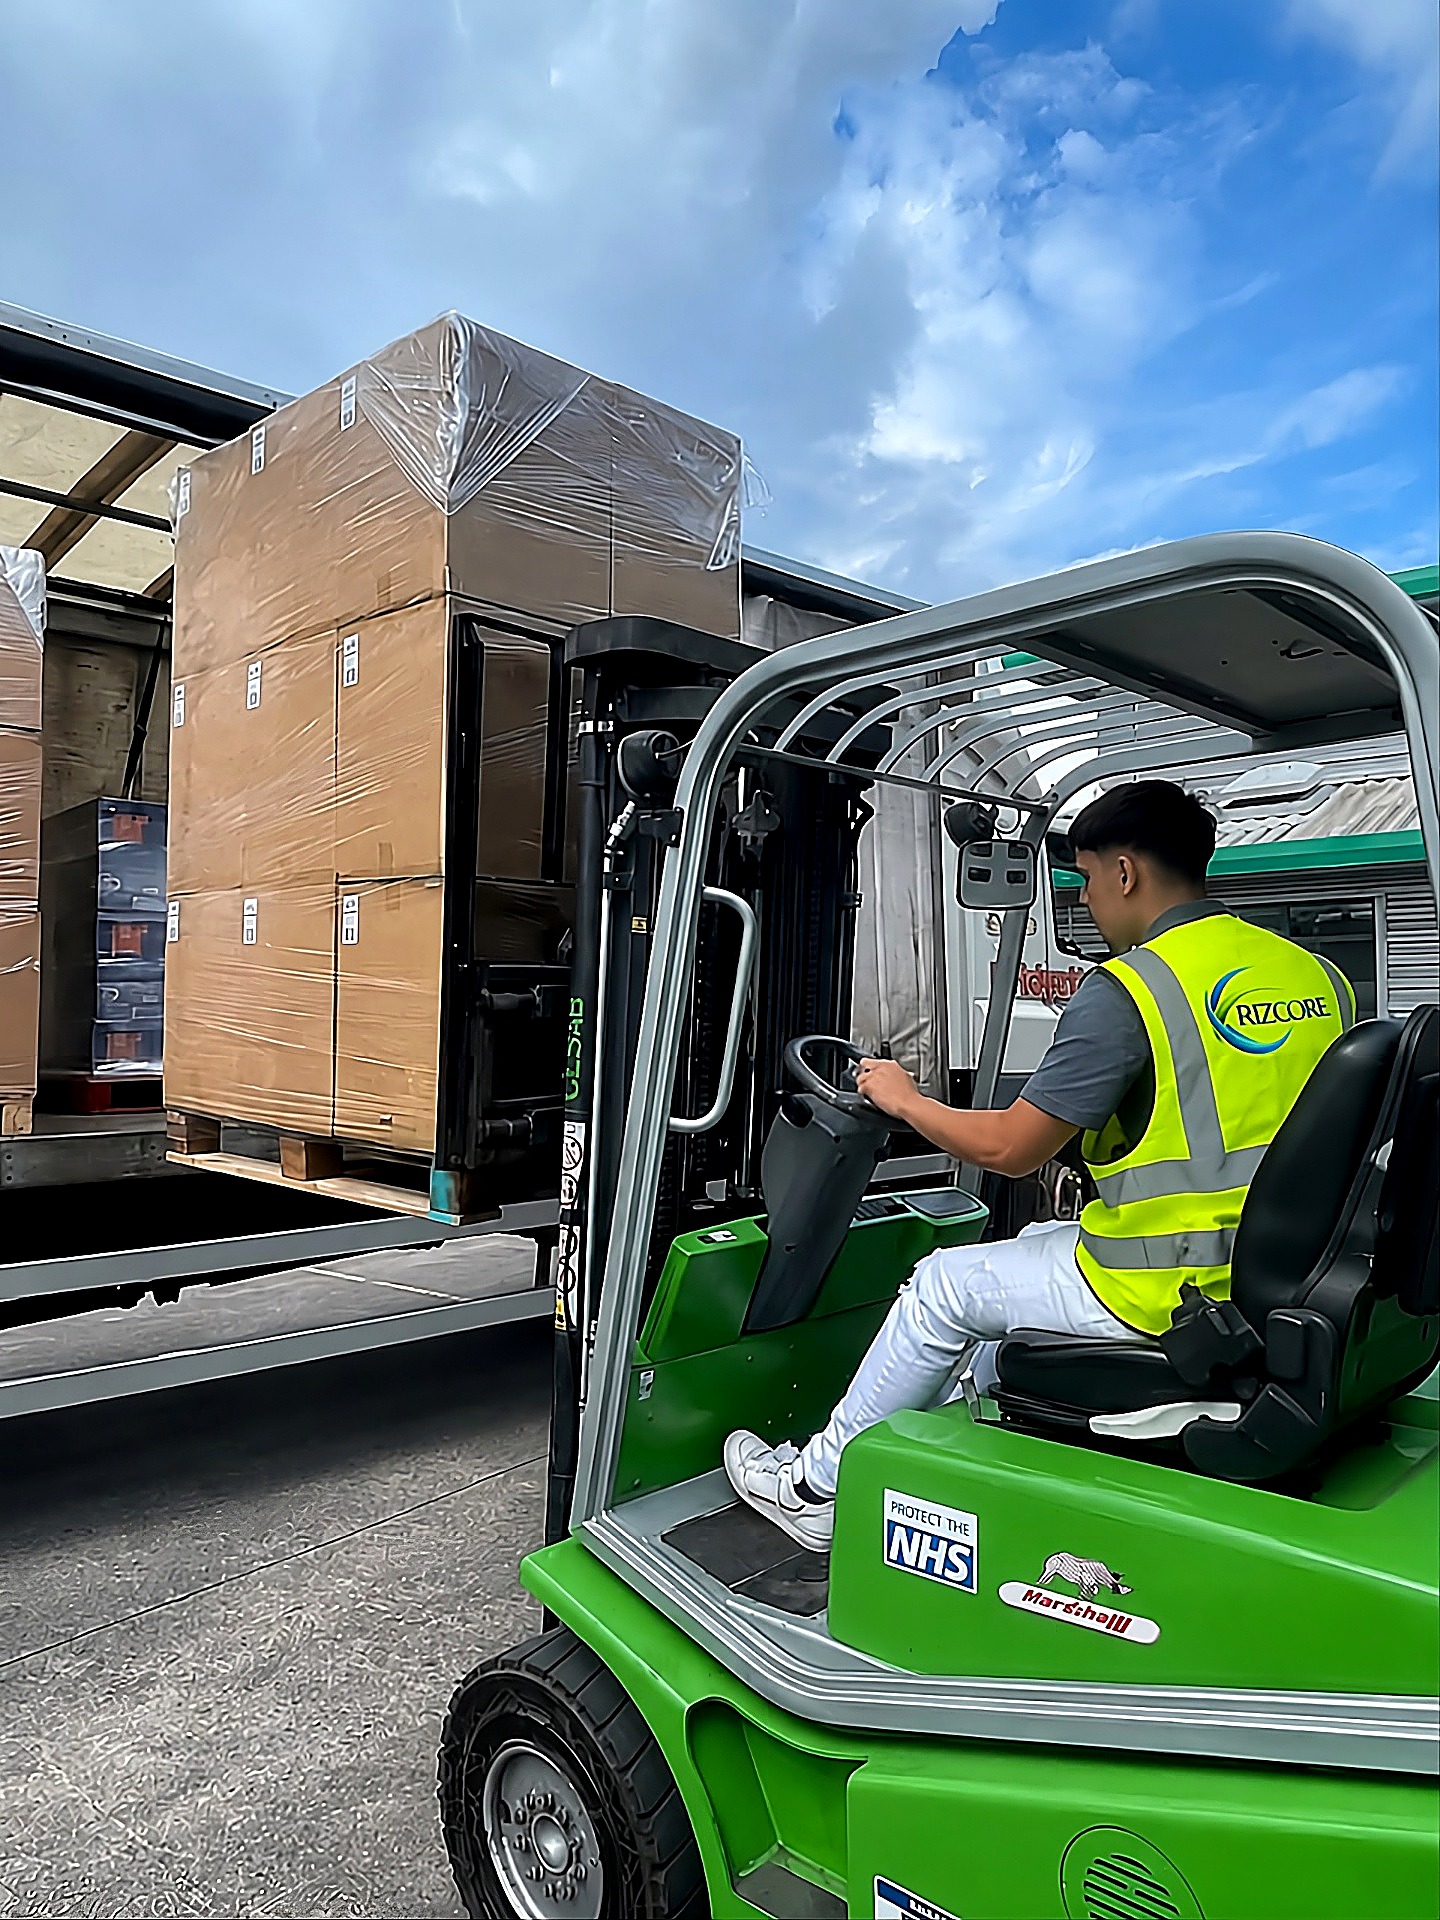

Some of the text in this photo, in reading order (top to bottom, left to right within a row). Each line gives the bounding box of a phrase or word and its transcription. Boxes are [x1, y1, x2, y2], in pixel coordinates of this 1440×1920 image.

[1235, 996, 1332, 1026] RIZCORE
[890, 1500, 970, 1537] PROTECT THE
[888, 1524, 971, 1583] NHS
